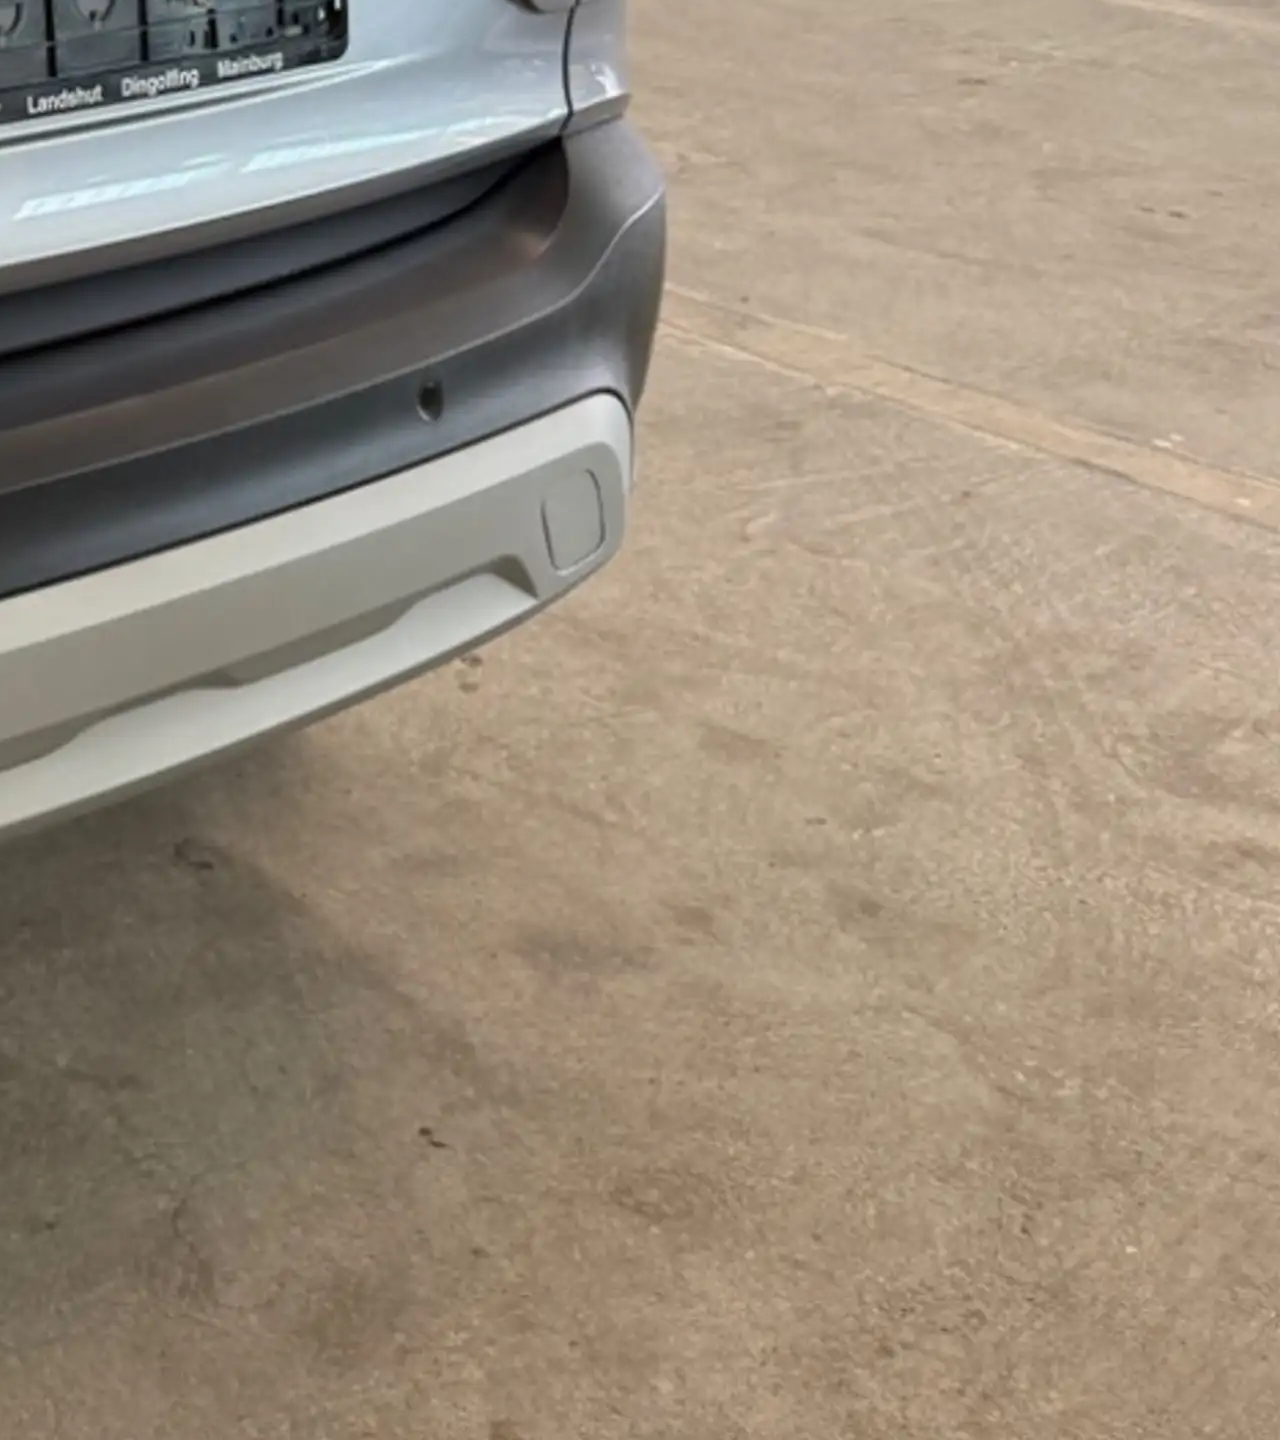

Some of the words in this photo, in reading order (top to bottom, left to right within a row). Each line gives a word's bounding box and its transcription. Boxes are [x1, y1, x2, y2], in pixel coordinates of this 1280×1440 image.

[26, 84, 104, 115] Landshut
[121, 67, 200, 98] Dingolfing
[217, 51, 284, 79] Mainburg
